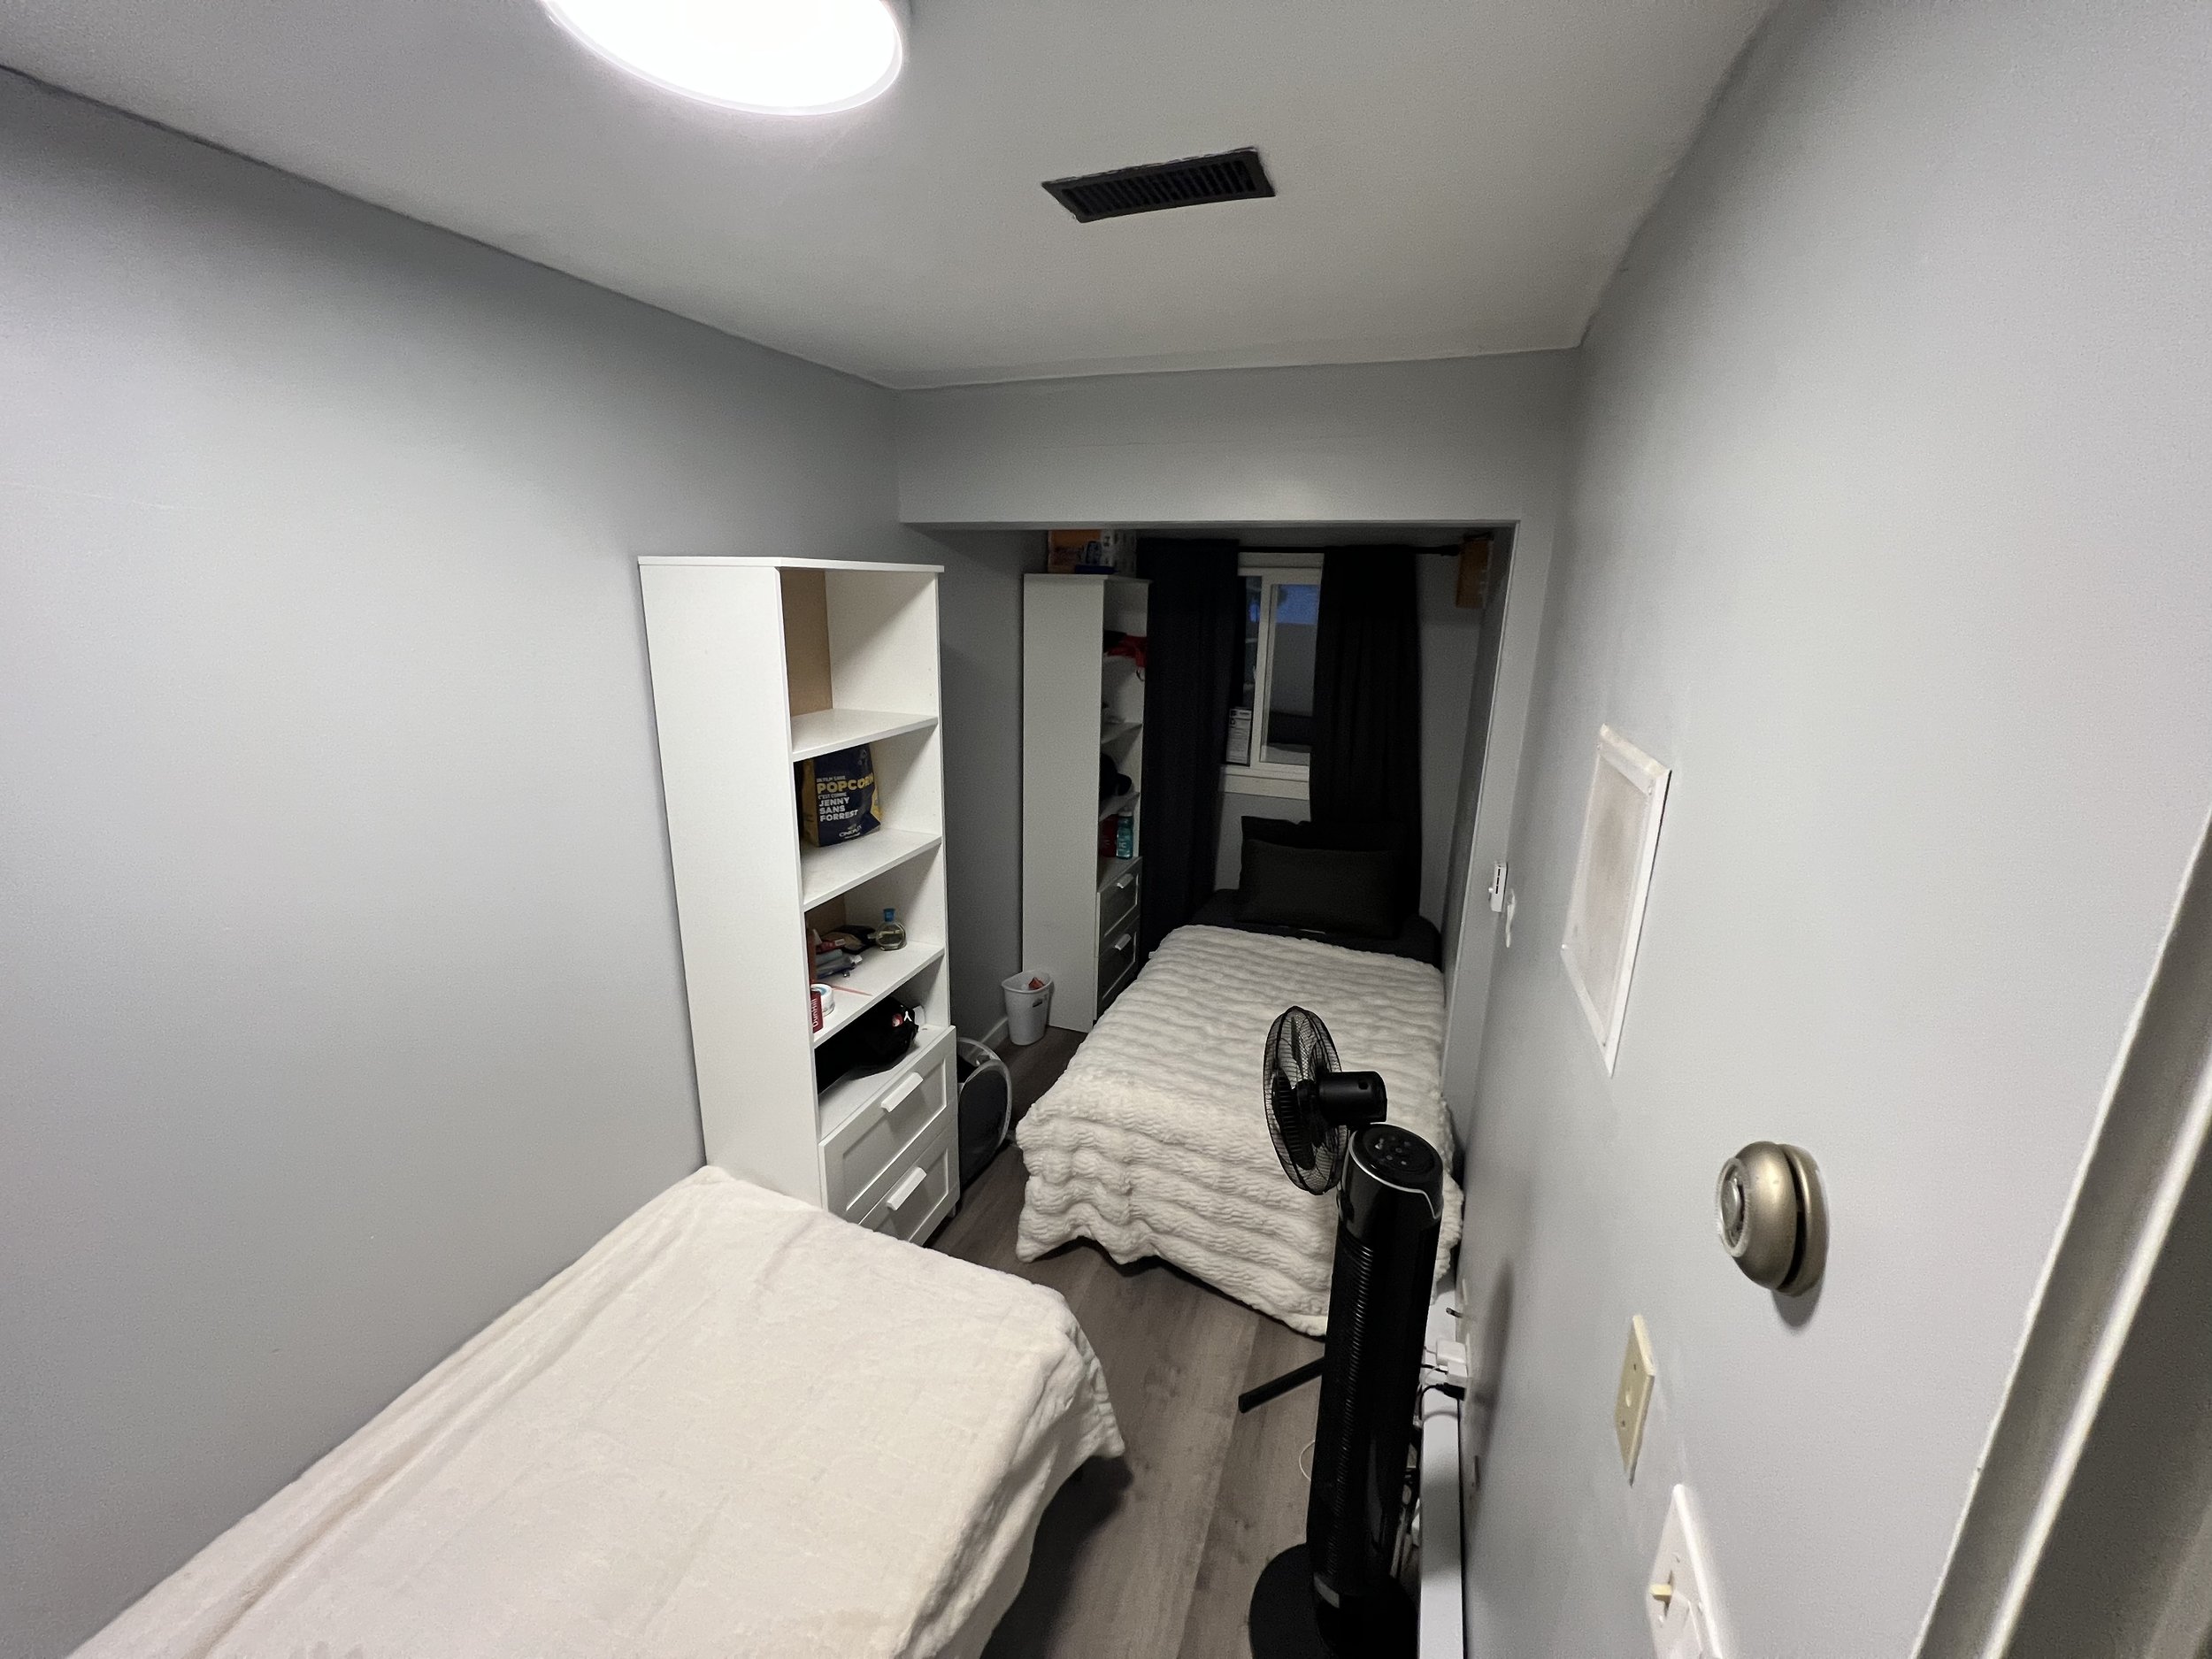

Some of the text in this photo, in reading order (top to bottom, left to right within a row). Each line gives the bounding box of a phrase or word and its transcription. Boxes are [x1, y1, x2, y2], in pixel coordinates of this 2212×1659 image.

[817, 772, 874, 795] POPCORN
[819, 796, 850, 807] JENNY
[819, 805, 846, 815] SANS
[820, 810, 859, 822] FORREST
